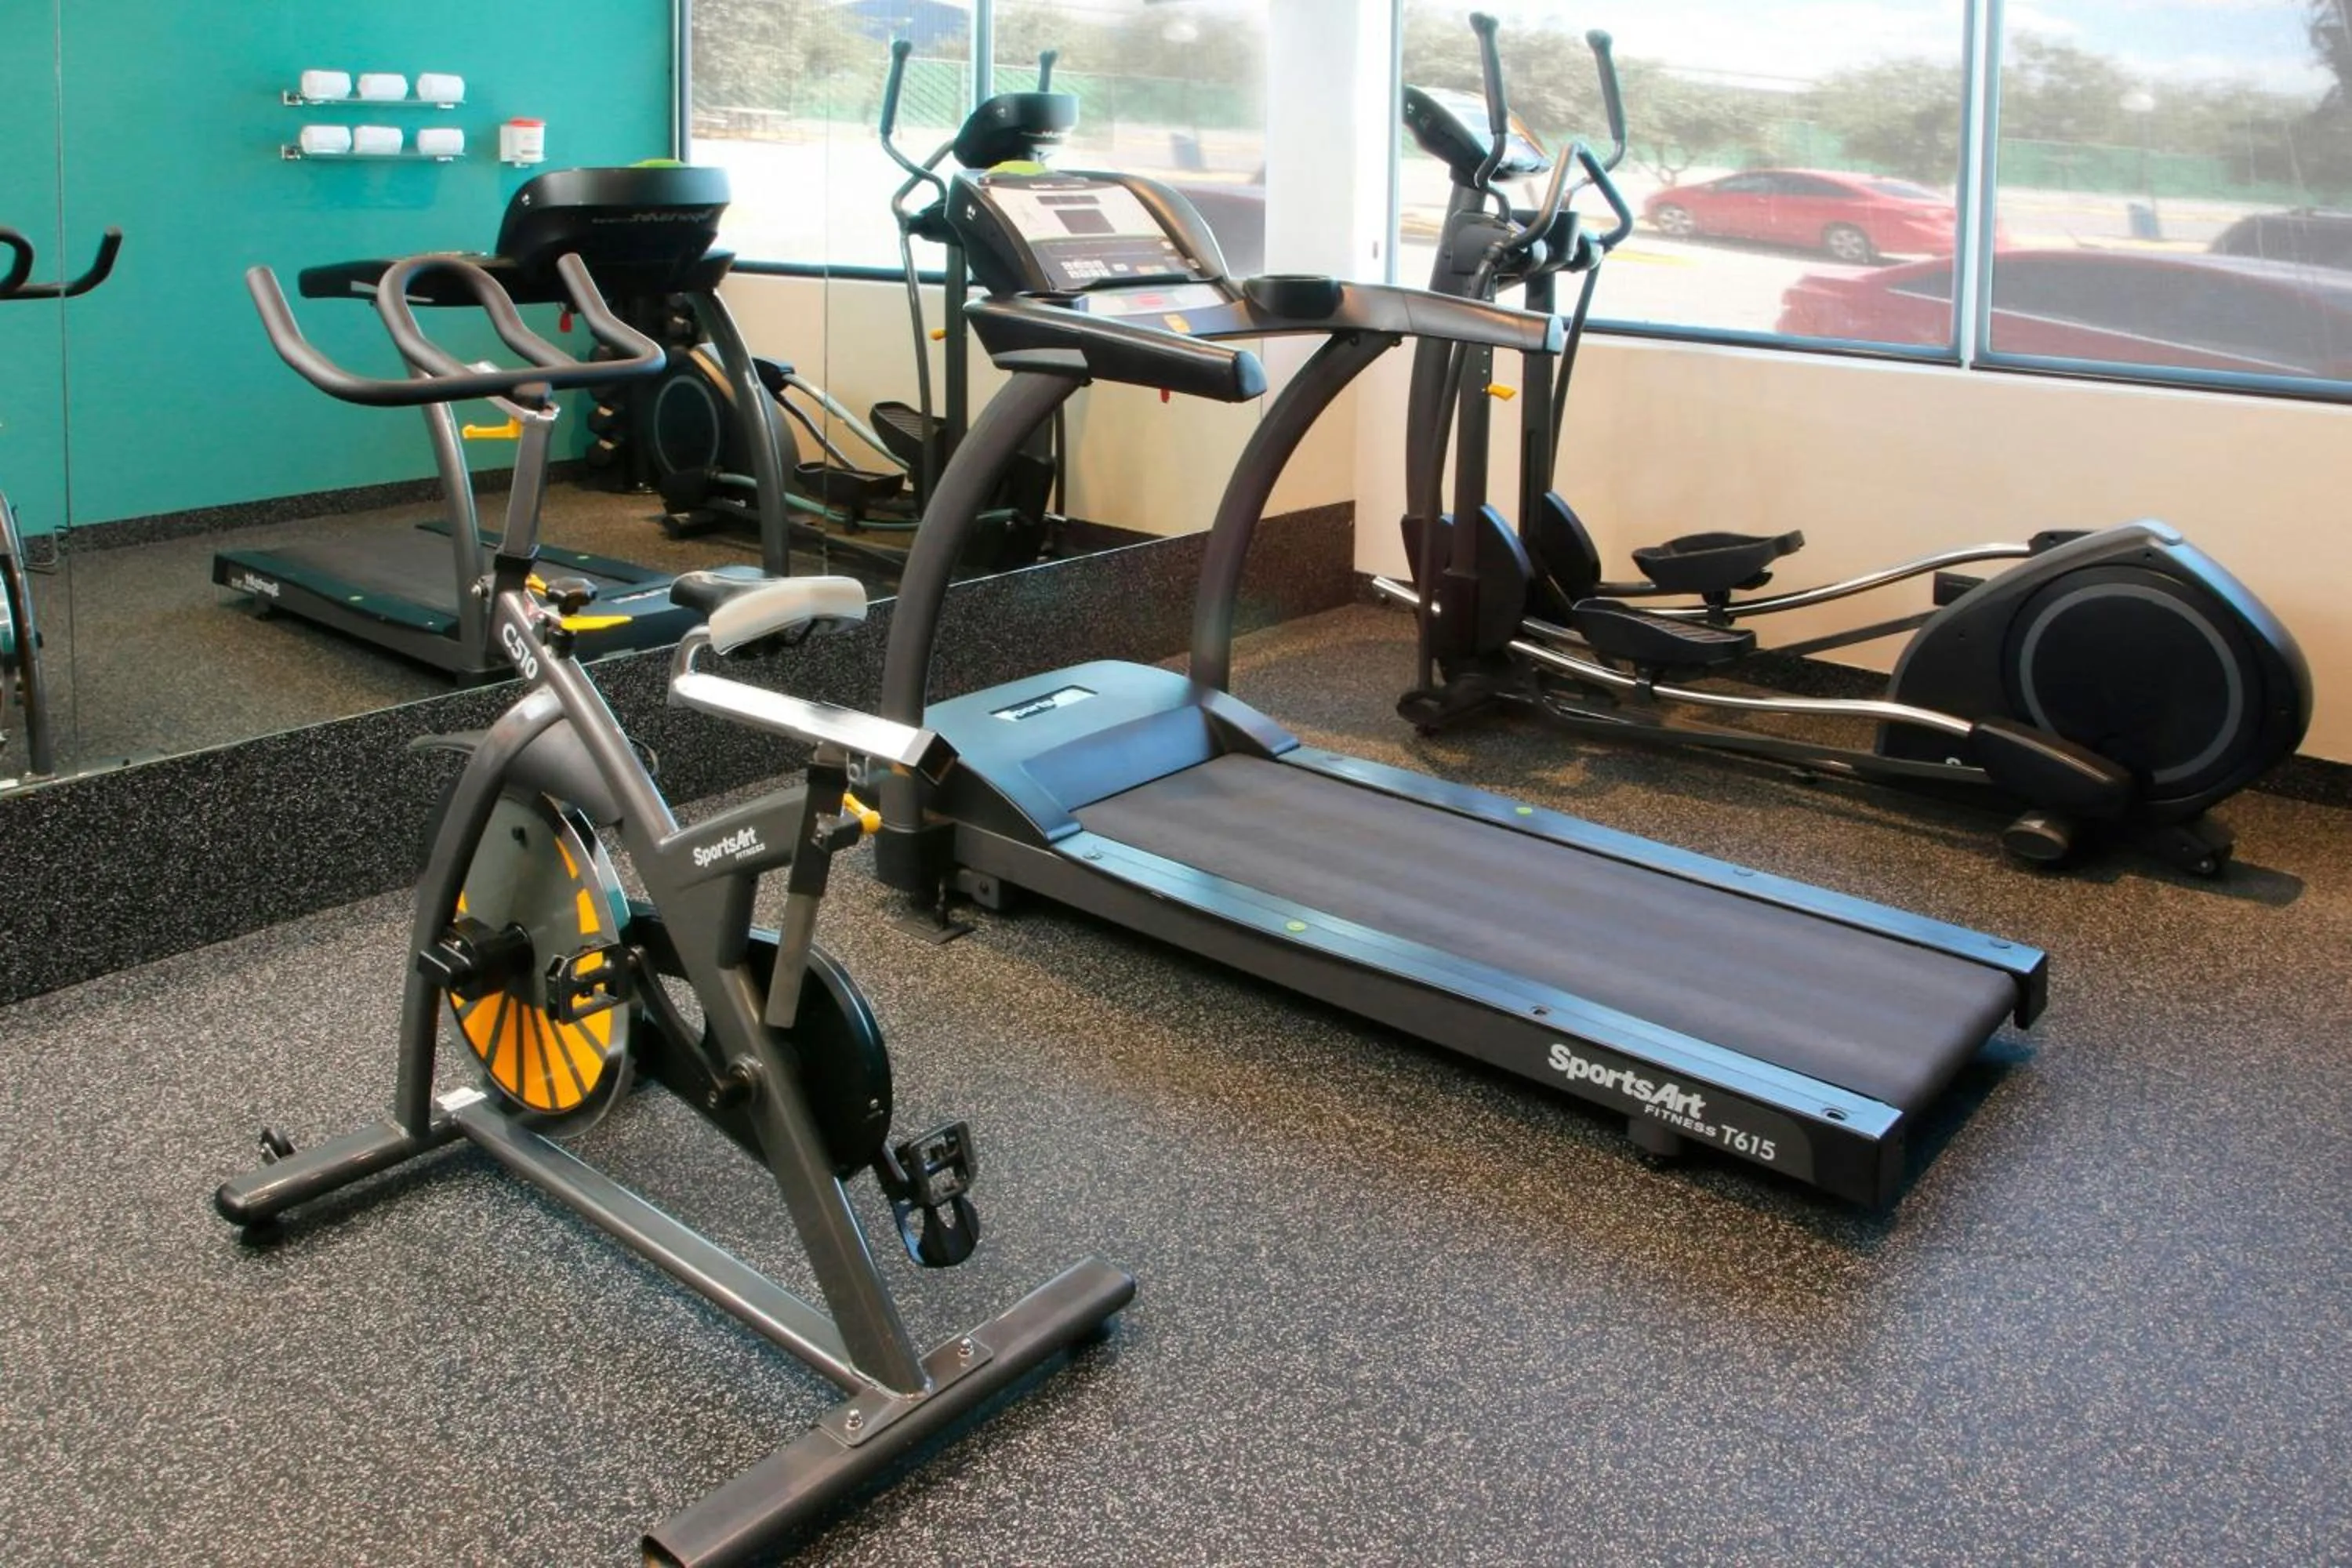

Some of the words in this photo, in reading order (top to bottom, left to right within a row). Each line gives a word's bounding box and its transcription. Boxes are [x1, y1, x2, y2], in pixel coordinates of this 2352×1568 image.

[503, 623, 538, 680] C510
[693, 827, 757, 867] SportsArt
[1548, 1044, 1706, 1119] SportsArt
[1644, 1105, 1717, 1138] FITNESS
[1721, 1124, 1777, 1161] T615
